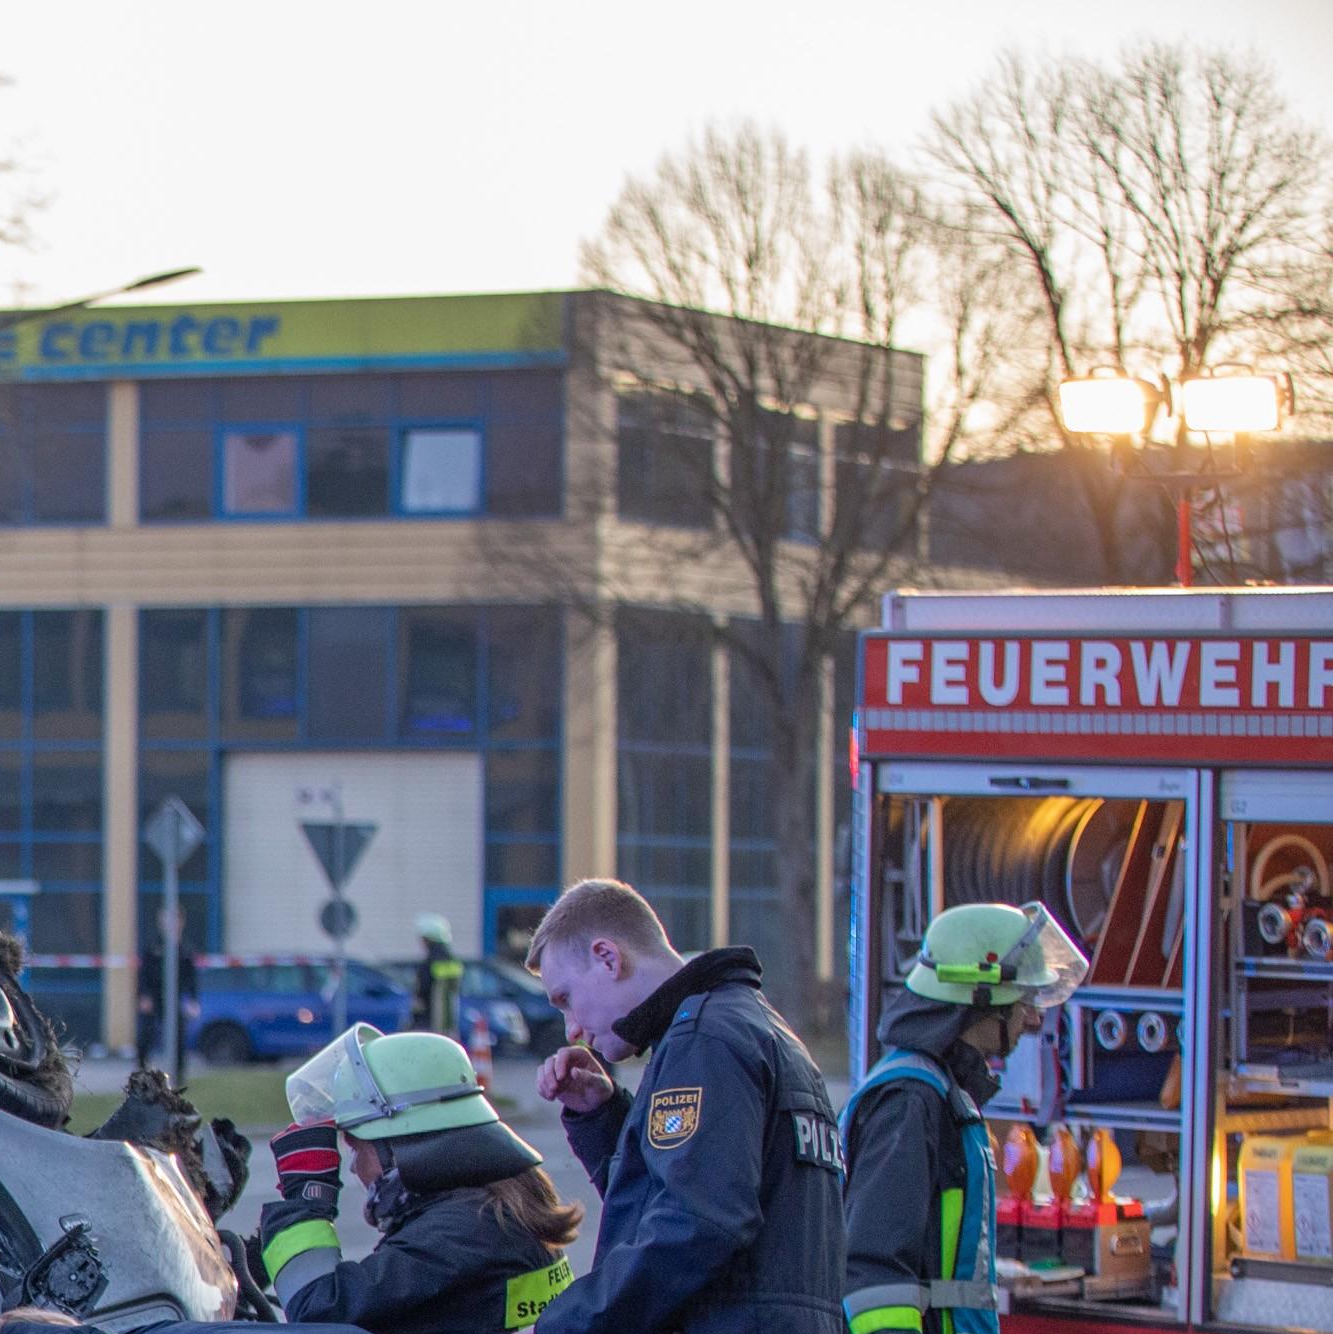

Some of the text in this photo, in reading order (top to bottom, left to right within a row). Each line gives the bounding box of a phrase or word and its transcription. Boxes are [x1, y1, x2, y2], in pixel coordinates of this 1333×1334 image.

[39, 313, 280, 358] center
[886, 640, 1333, 709] FEUERWEHR
[654, 1094, 698, 1108] POLIZEI
